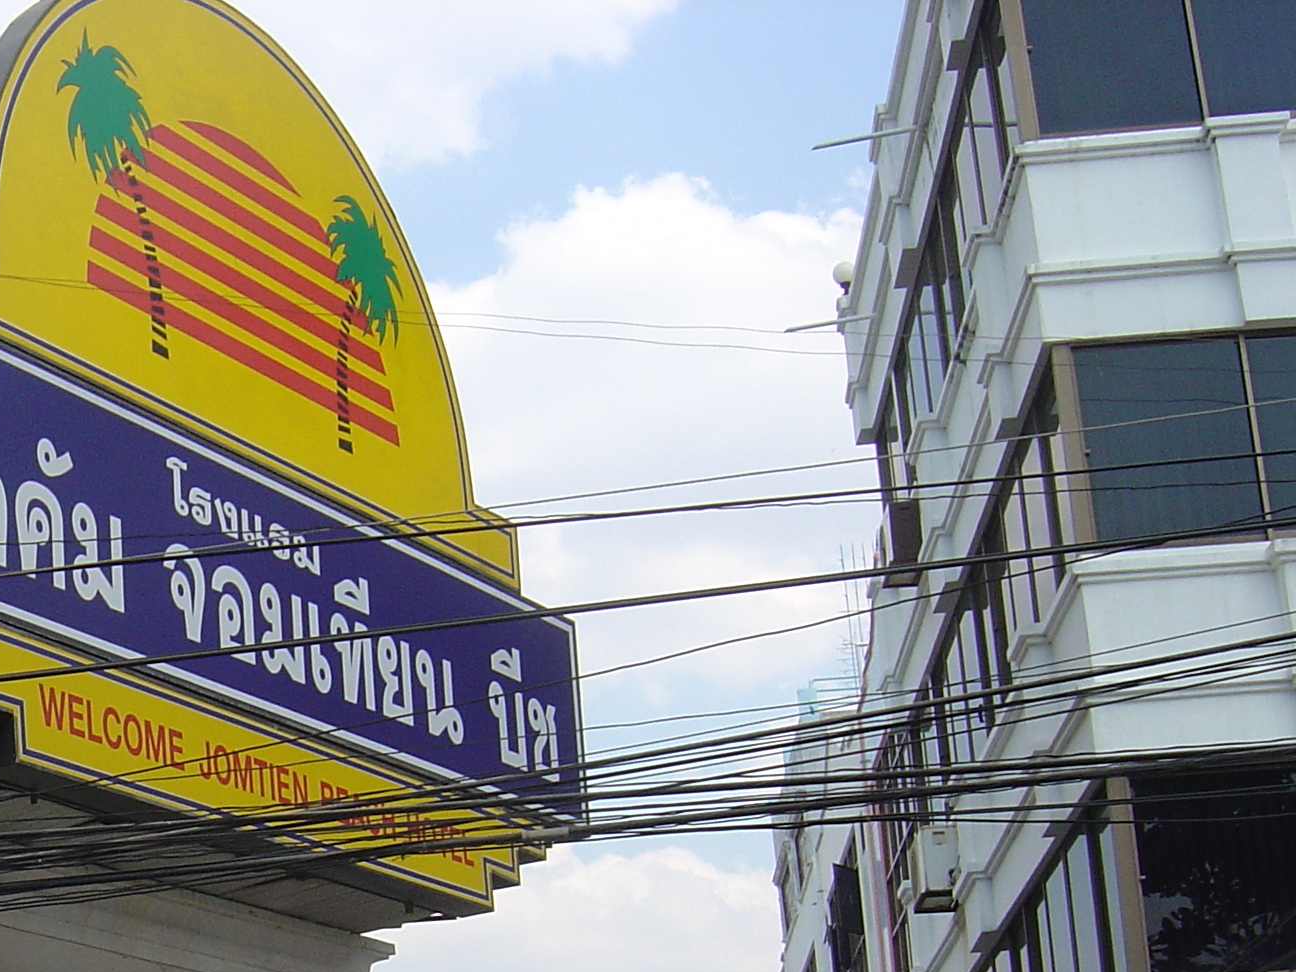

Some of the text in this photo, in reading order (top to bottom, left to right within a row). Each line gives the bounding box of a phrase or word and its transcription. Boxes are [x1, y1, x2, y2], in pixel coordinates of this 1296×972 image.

[166, 457, 321, 576] โรงแรม
[163, 543, 560, 782] จอมเทียน บีช
[38, 683, 186, 772] WELCOME
[199, 741, 309, 812] JOMTIEN
